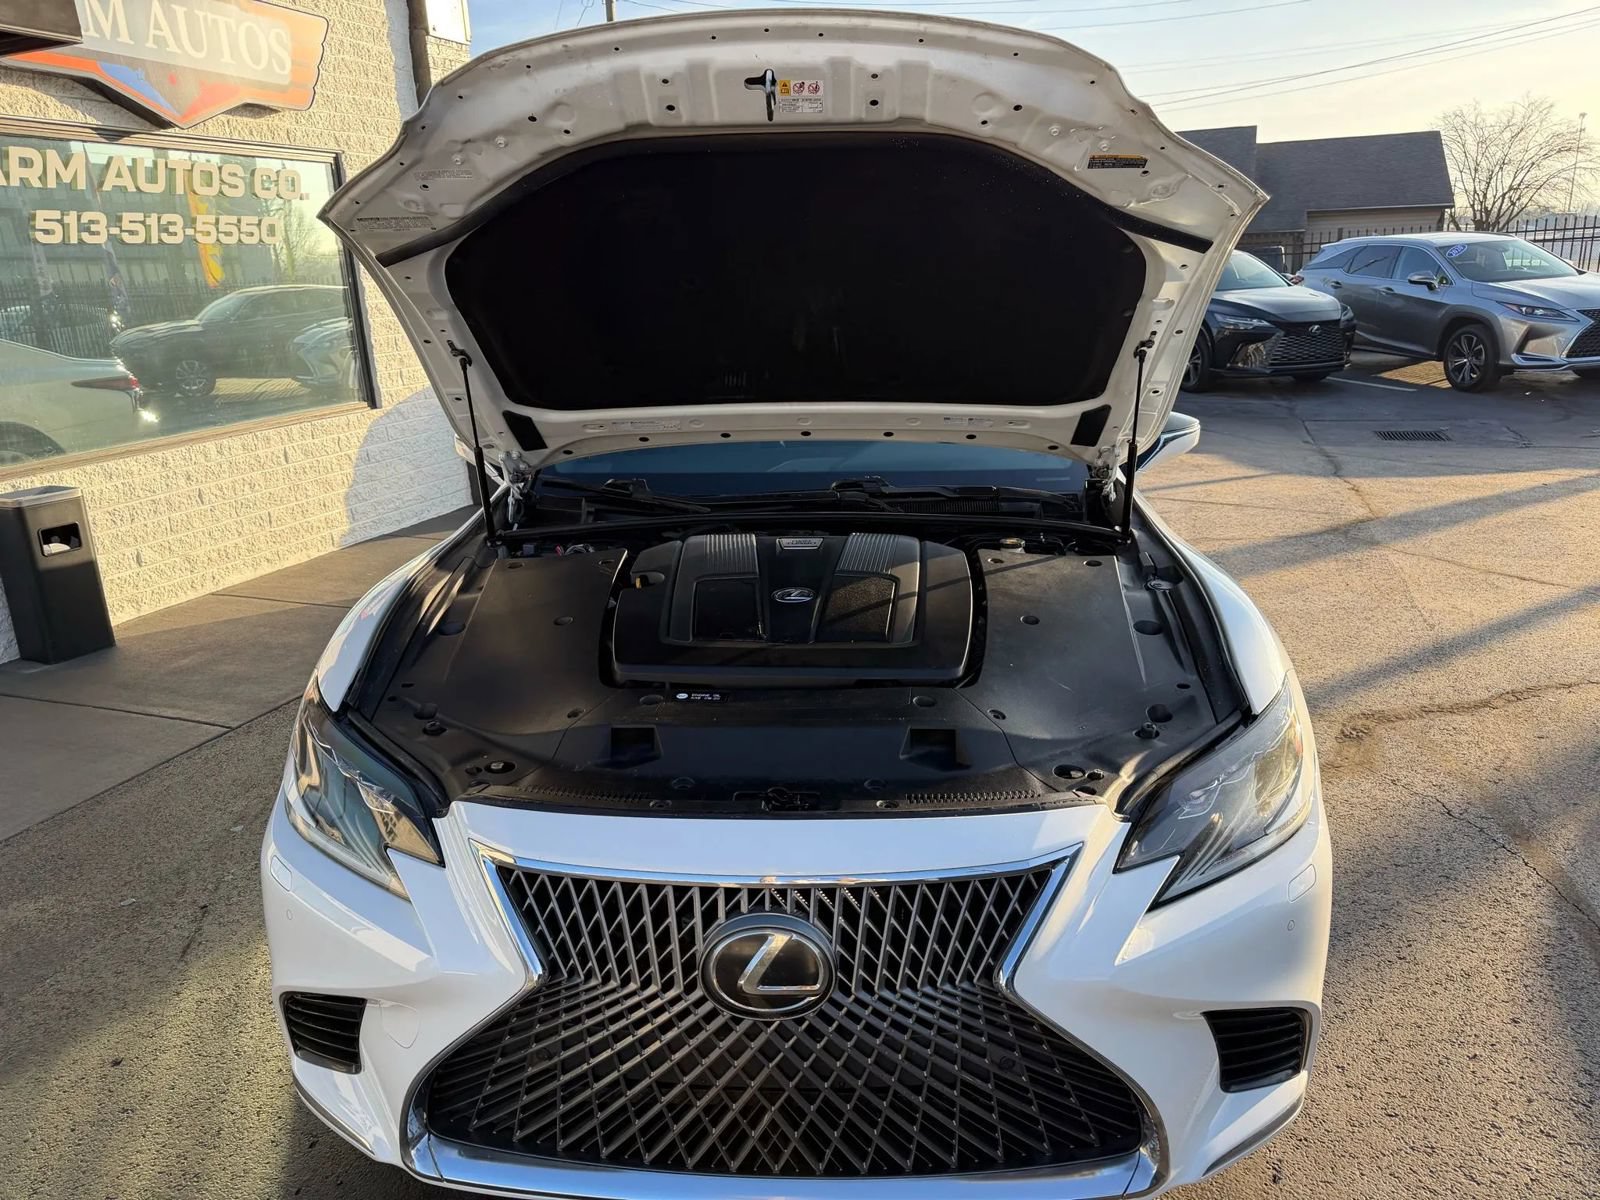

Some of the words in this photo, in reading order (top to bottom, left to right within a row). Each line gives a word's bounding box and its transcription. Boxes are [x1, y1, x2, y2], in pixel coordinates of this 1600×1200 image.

[144, 0, 292, 75] AUTOS
[0, 146, 87, 190] RM
[102, 155, 246, 198] AUTOS
[253, 167, 310, 200] CO.
[34, 209, 283, 245] 513-513-5550
